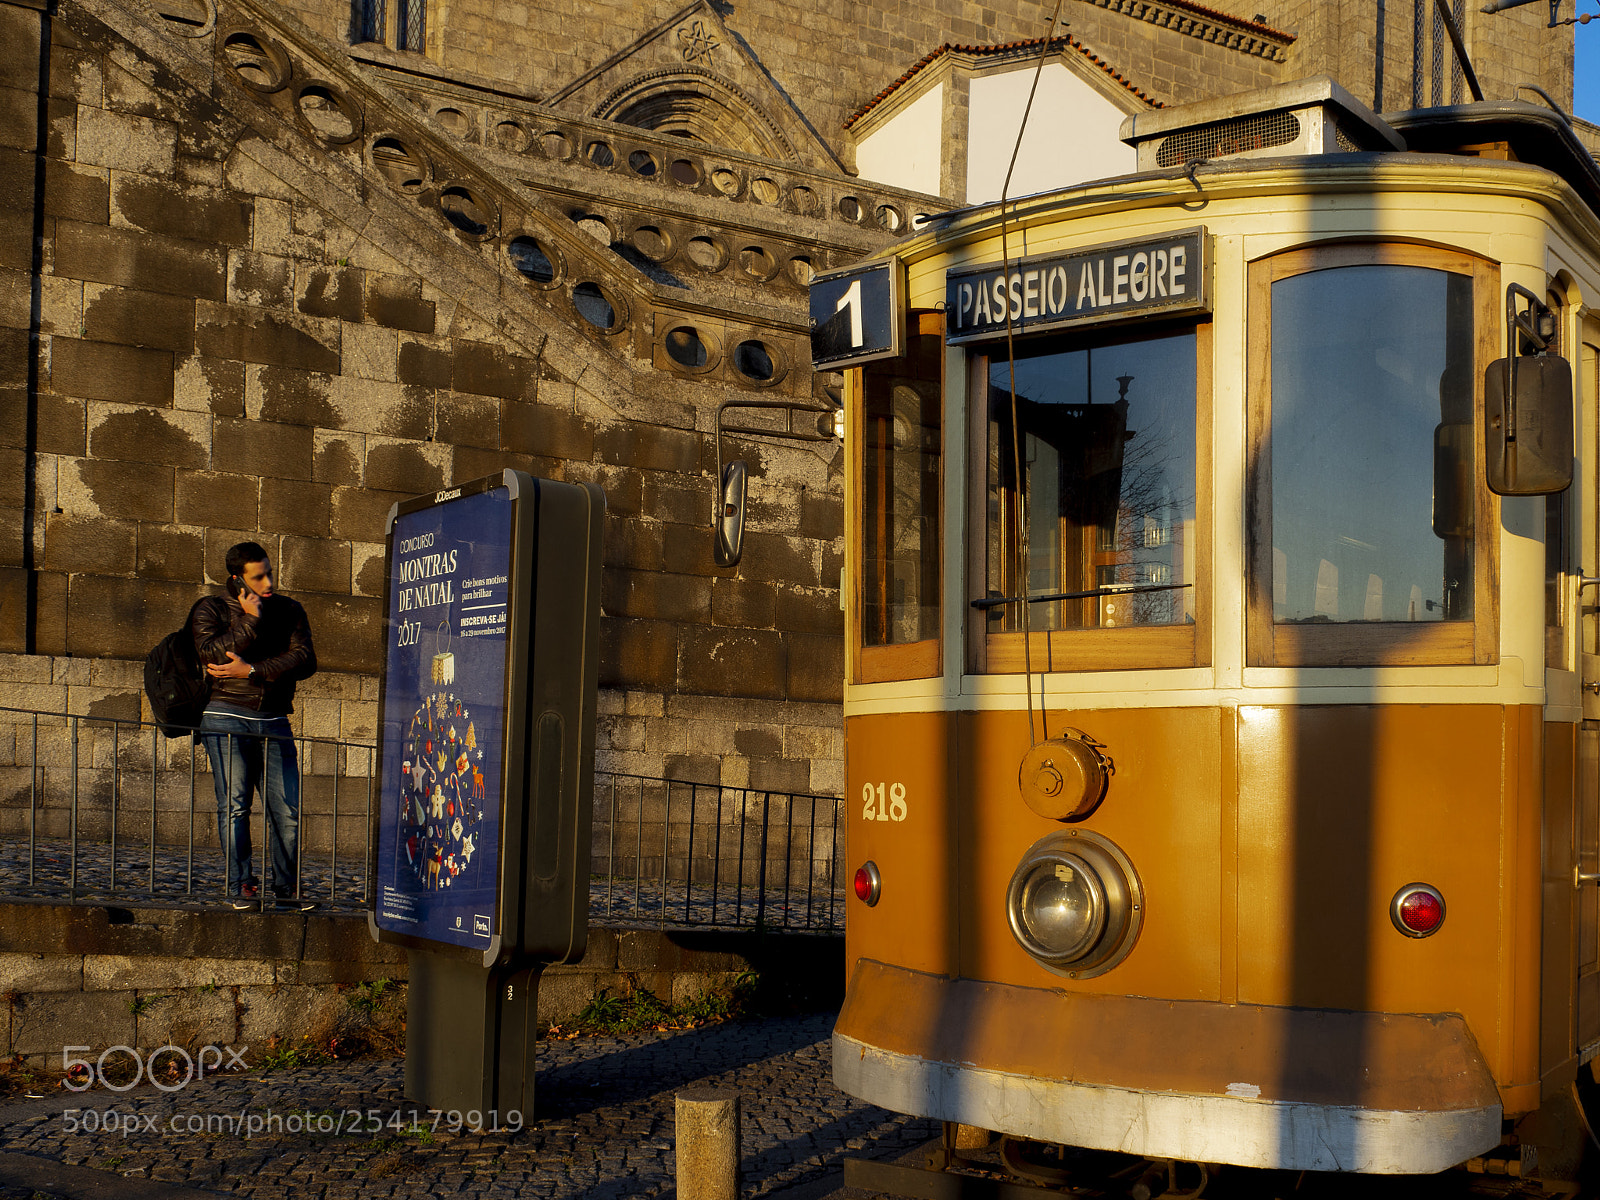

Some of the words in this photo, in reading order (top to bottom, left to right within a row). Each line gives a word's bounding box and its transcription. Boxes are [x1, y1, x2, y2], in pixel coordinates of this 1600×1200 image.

[956, 265, 1067, 329] PASSEIO
[1075, 245, 1187, 310] ALEGRE
[836, 279, 863, 348] 1
[434, 488, 461, 503] JCDecaux
[400, 532, 434, 554] CONCURSO
[399, 549, 458, 584] MONTRAS
[462, 579, 472, 589] Crie
[472, 578, 485, 587] bons
[486, 574, 507, 585] motivos
[398, 588, 413, 612] DE
[413, 580, 455, 609] NATAL
[462, 592, 473, 603] para
[473, 588, 493, 599] brilhar
[461, 614, 497, 627] INSCREVA-SE
[474, 626, 496, 636] novembro
[862, 782, 908, 822] 218
